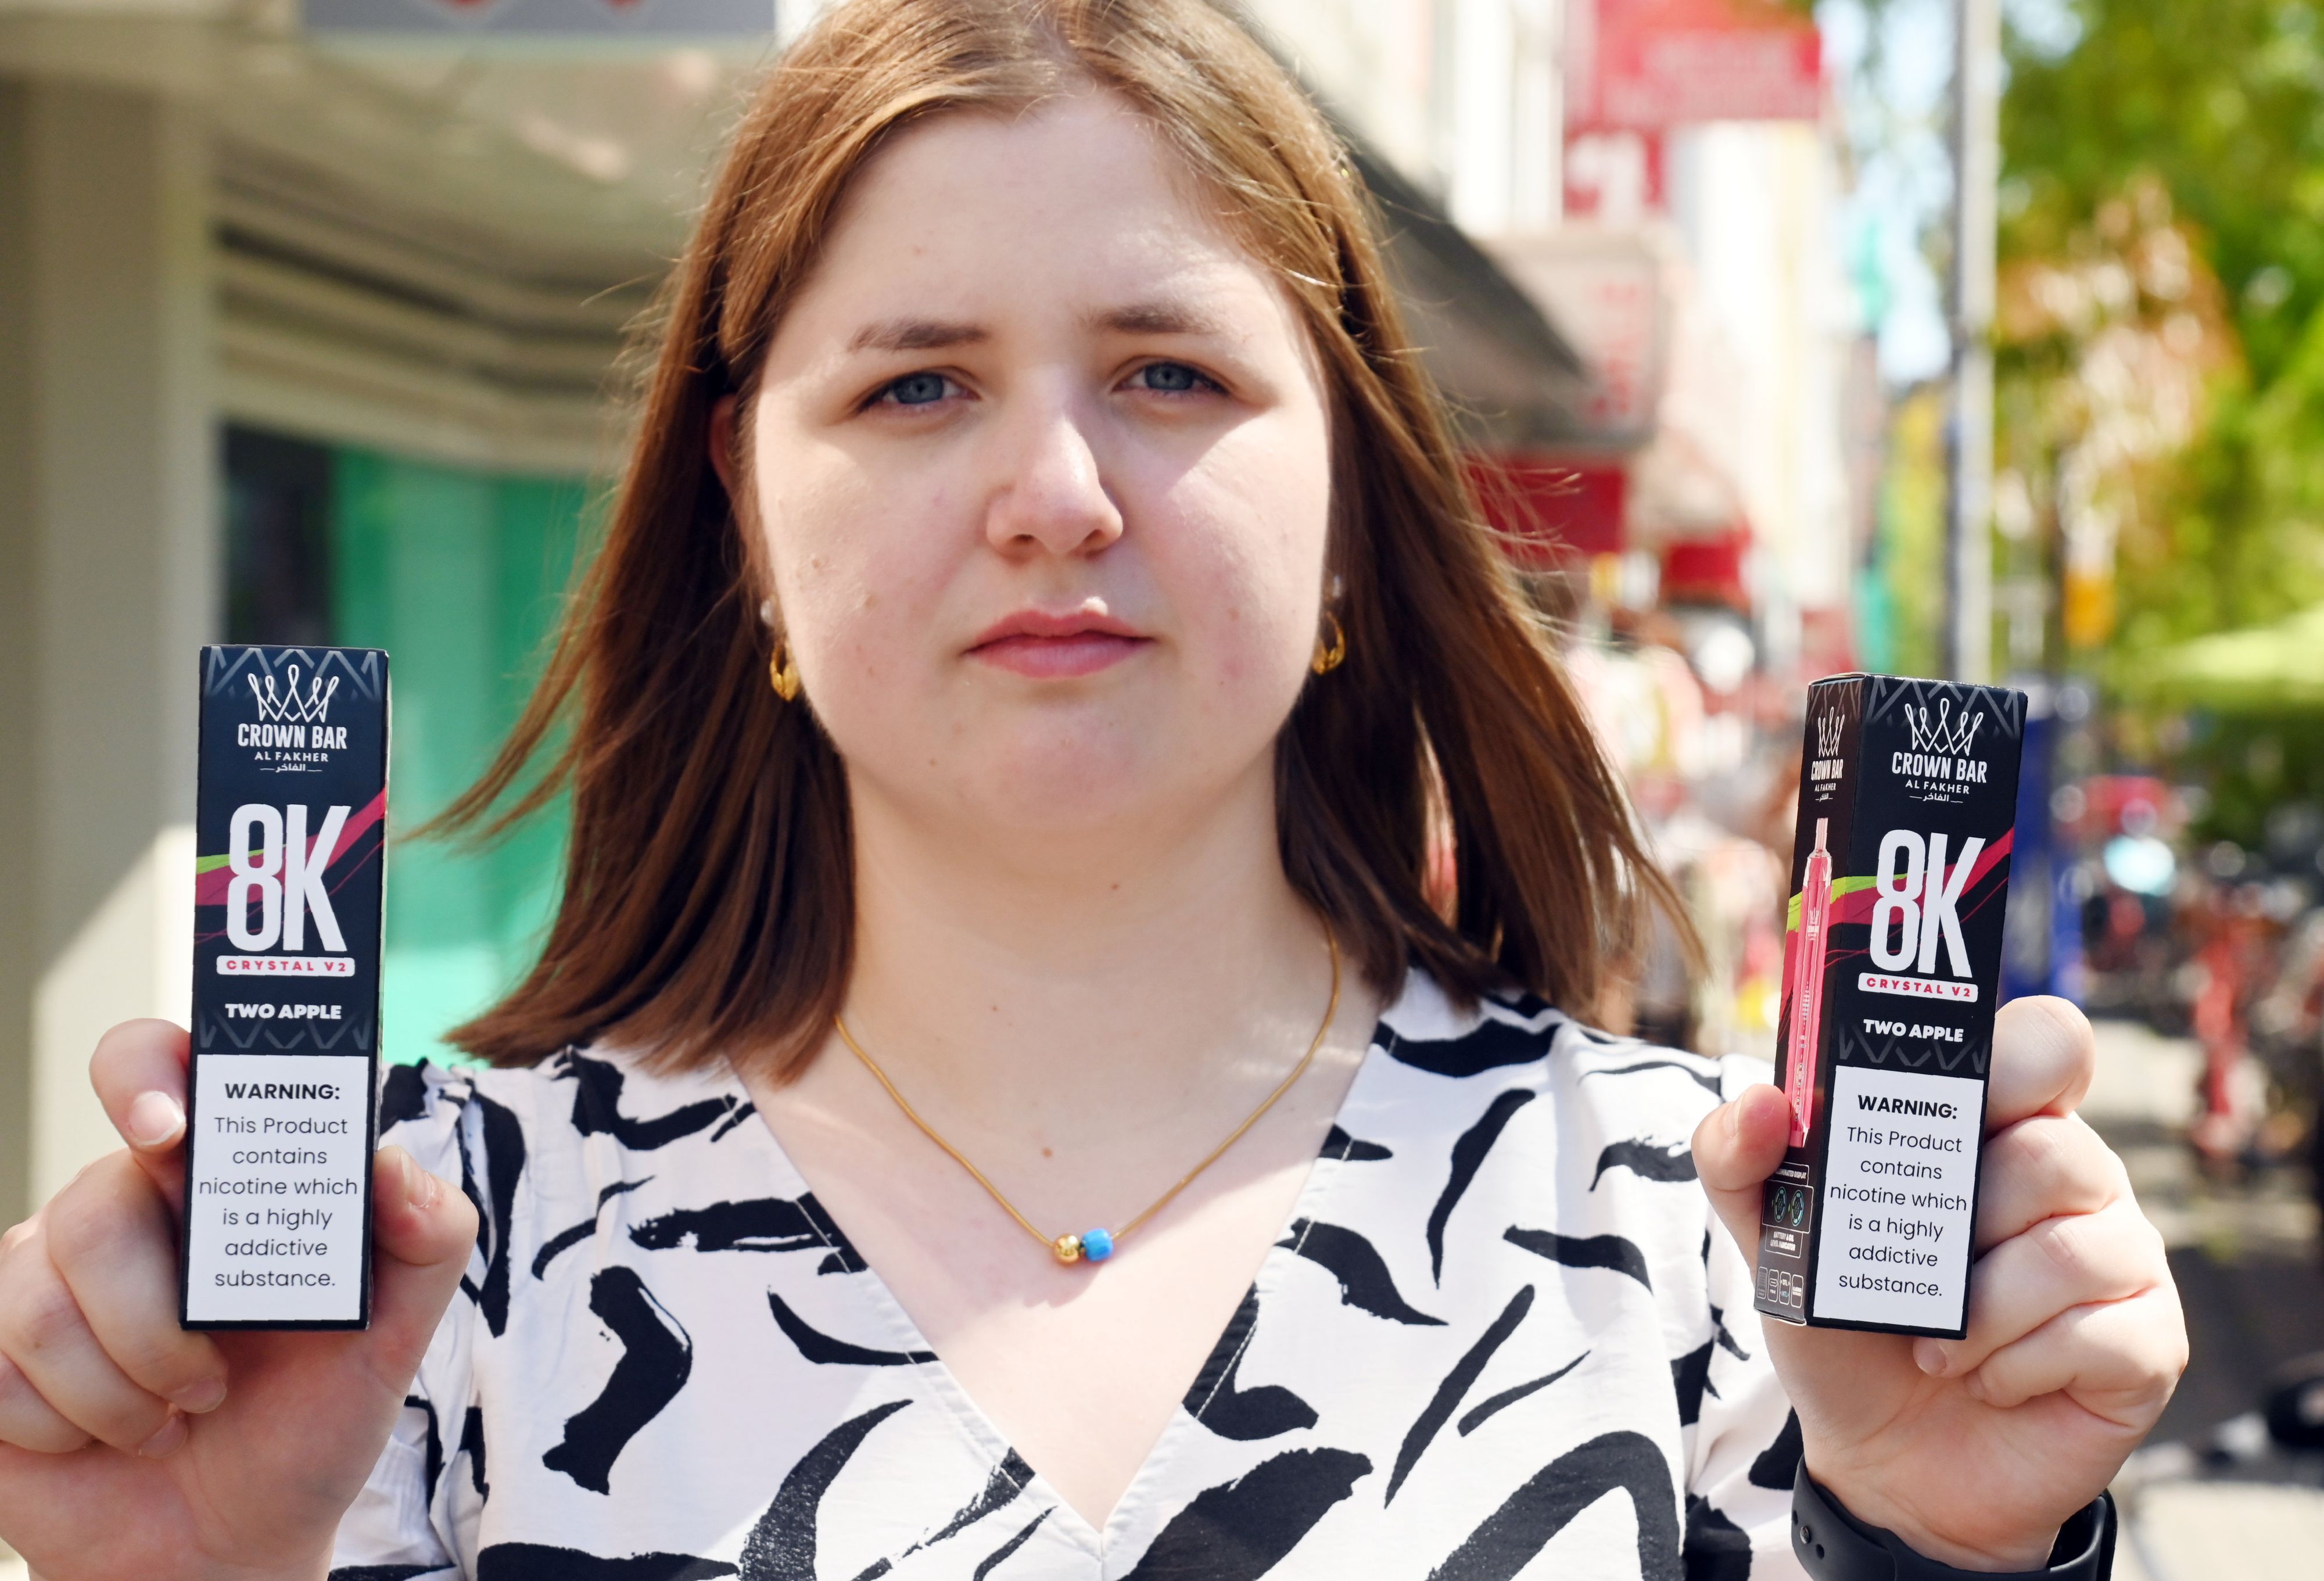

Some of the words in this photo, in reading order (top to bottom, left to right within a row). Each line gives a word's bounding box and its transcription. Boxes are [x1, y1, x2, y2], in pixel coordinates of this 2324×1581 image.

[238, 723, 305, 748] CROWN
[312, 726, 347, 749] BAR
[254, 751, 271, 760] AL
[275, 752, 328, 762] FAKHER
[275, 763, 306, 772] الفاخر
[1811, 759, 1831, 781] CROWN
[1831, 759, 1844, 779] BAR
[1892, 751, 1952, 779] CROWN
[1956, 758, 1988, 783] BAR
[1814, 784, 1820, 792] AL
[1820, 783, 1836, 791] FAKHER
[1905, 779, 1920, 789] AL
[1924, 781, 1970, 794] FAKHER
[1923, 792, 1949, 802] الفاخر
[227, 803, 351, 951] 8K
[1868, 829, 1986, 978] 8K
[226, 959, 314, 972] CRYSTAL
[324, 962, 347, 973] V2
[1867, 977, 1943, 994] CRYSTAL
[1952, 987, 1970, 997] V2
[225, 1003, 274, 1019] TWO
[278, 1004, 342, 1019] APPLE
[1863, 1019, 1907, 1037] TWO
[1909, 1024, 1964, 1042] APPLE
[225, 1083, 340, 1100] WARNING:
[1858, 1095, 1957, 1119] WARNING:
[214, 1117, 256, 1134] This
[264, 1117, 348, 1134] Product
[1847, 1127, 1883, 1145] This
[1889, 1131, 1962, 1153] Product
[233, 1148, 327, 1164] contains
[1860, 1160, 1942, 1180] contains
[199, 1177, 287, 1195] nicotine
[294, 1178, 357, 1195] which
[1830, 1184, 1906, 1205] nicotine
[1912, 1192, 1967, 1211] which
[223, 1208, 239, 1225] is
[246, 1212, 259, 1225] a
[268, 1209, 332, 1230] highly
[1849, 1214, 1863, 1230] is
[1868, 1220, 1880, 1232] a
[1887, 1217, 1943, 1242] highly
[225, 1239, 328, 1256] addictive
[1849, 1245, 1938, 1267] addictive
[215, 1270, 336, 1286] substance.
[1839, 1274, 1942, 1296] substance.
